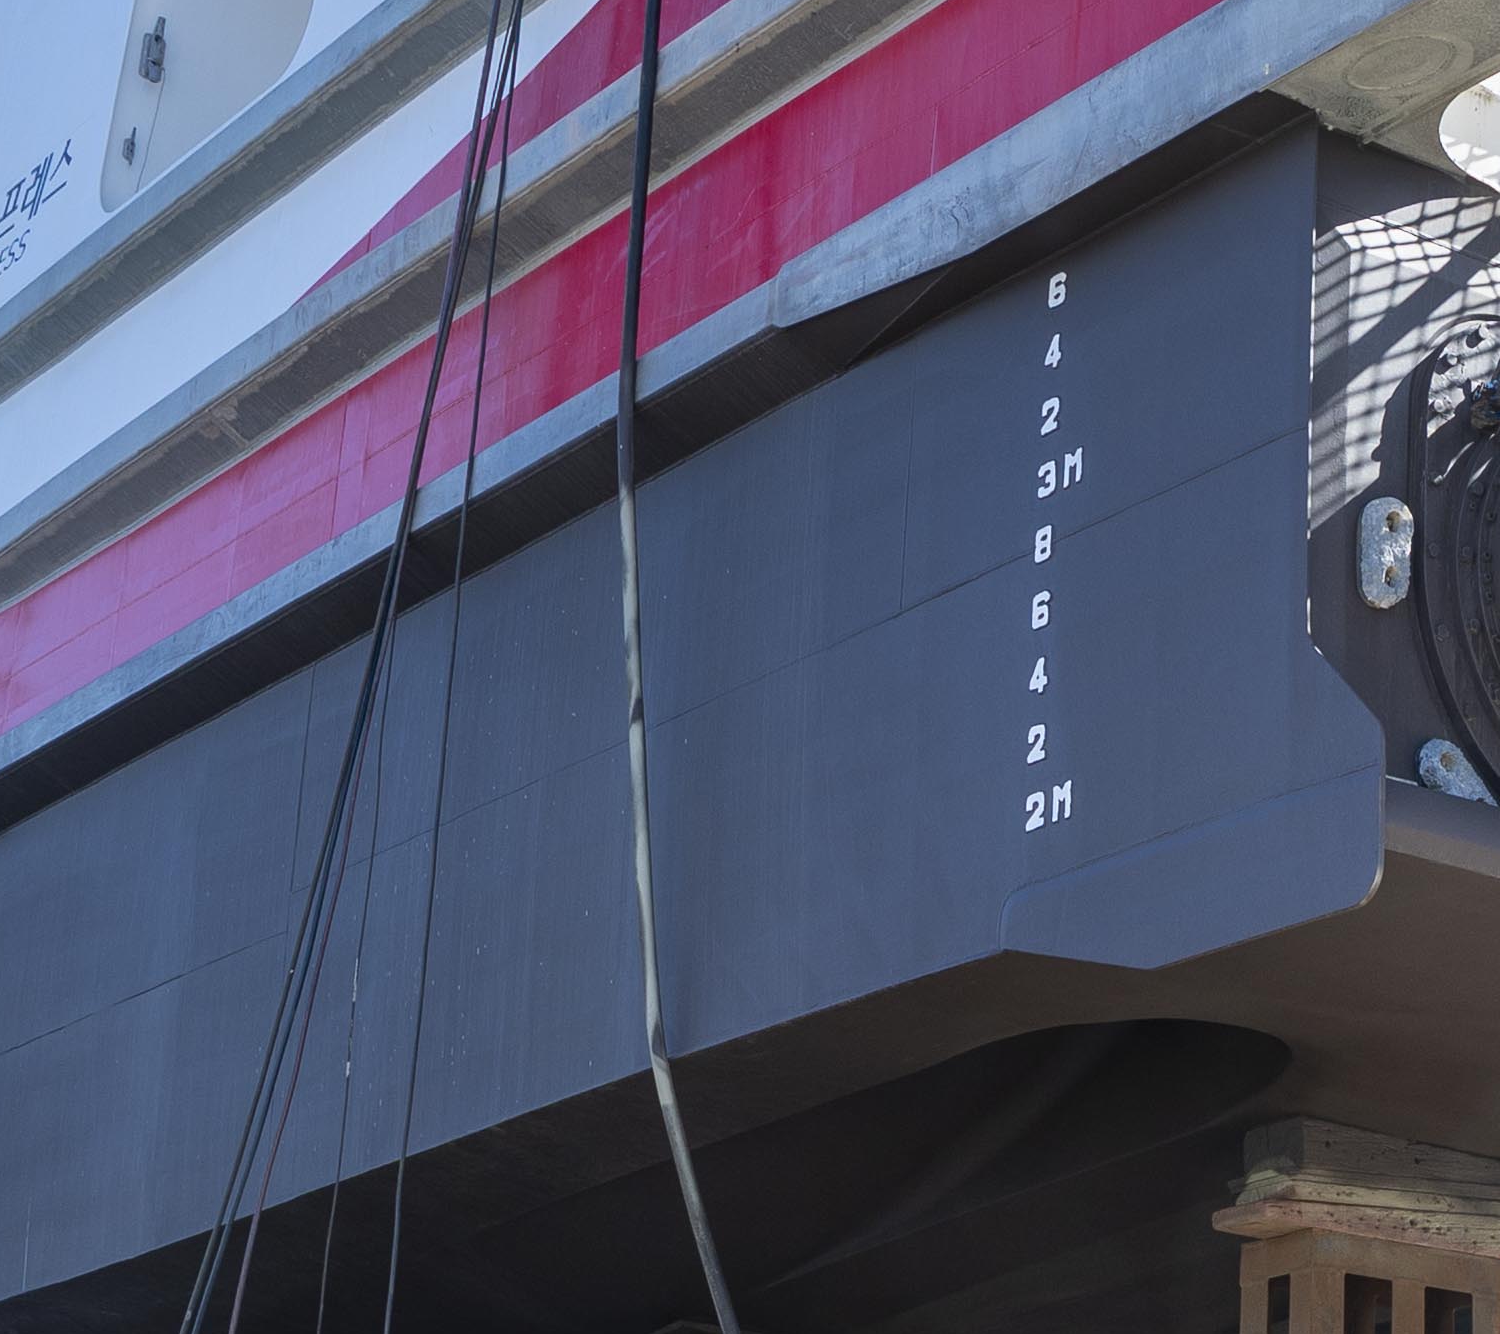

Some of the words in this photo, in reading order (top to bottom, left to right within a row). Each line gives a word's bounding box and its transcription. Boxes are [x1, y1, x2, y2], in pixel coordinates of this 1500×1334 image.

[1048, 272, 1066, 308] 6
[1044, 334, 1062, 367] 4
[1040, 397, 1060, 435] 2
[1034, 525, 1053, 563] 8
[1031, 591, 1051, 629] 6
[1029, 657, 1048, 693] 4
[1026, 724, 1046, 763] 2
